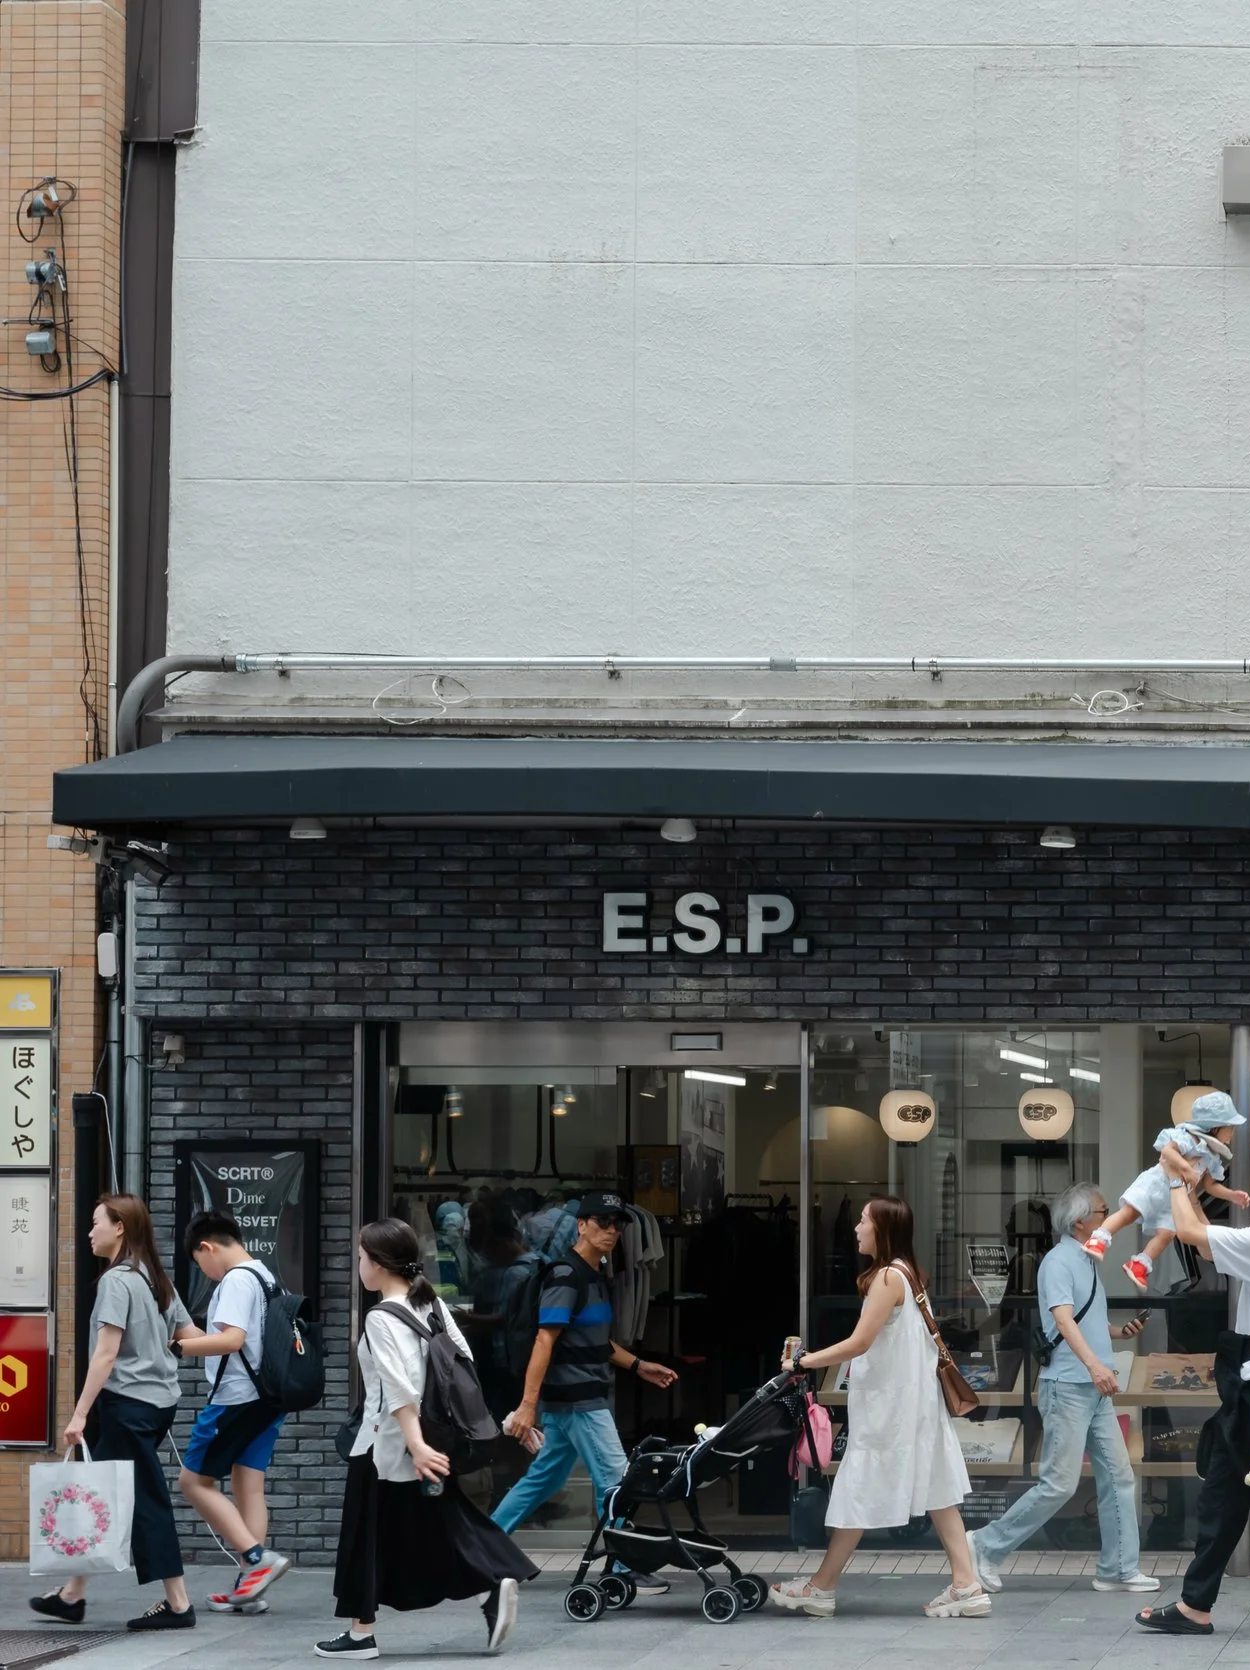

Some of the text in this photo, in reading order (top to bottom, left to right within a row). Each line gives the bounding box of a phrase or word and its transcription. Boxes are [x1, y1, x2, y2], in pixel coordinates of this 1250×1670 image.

[603, 892, 809, 954] E.S.P.
[11, 1046, 35, 1158] ほぐしや
[234, 1215, 278, 1227] SSVET
[242, 1239, 276, 1255] ntley
